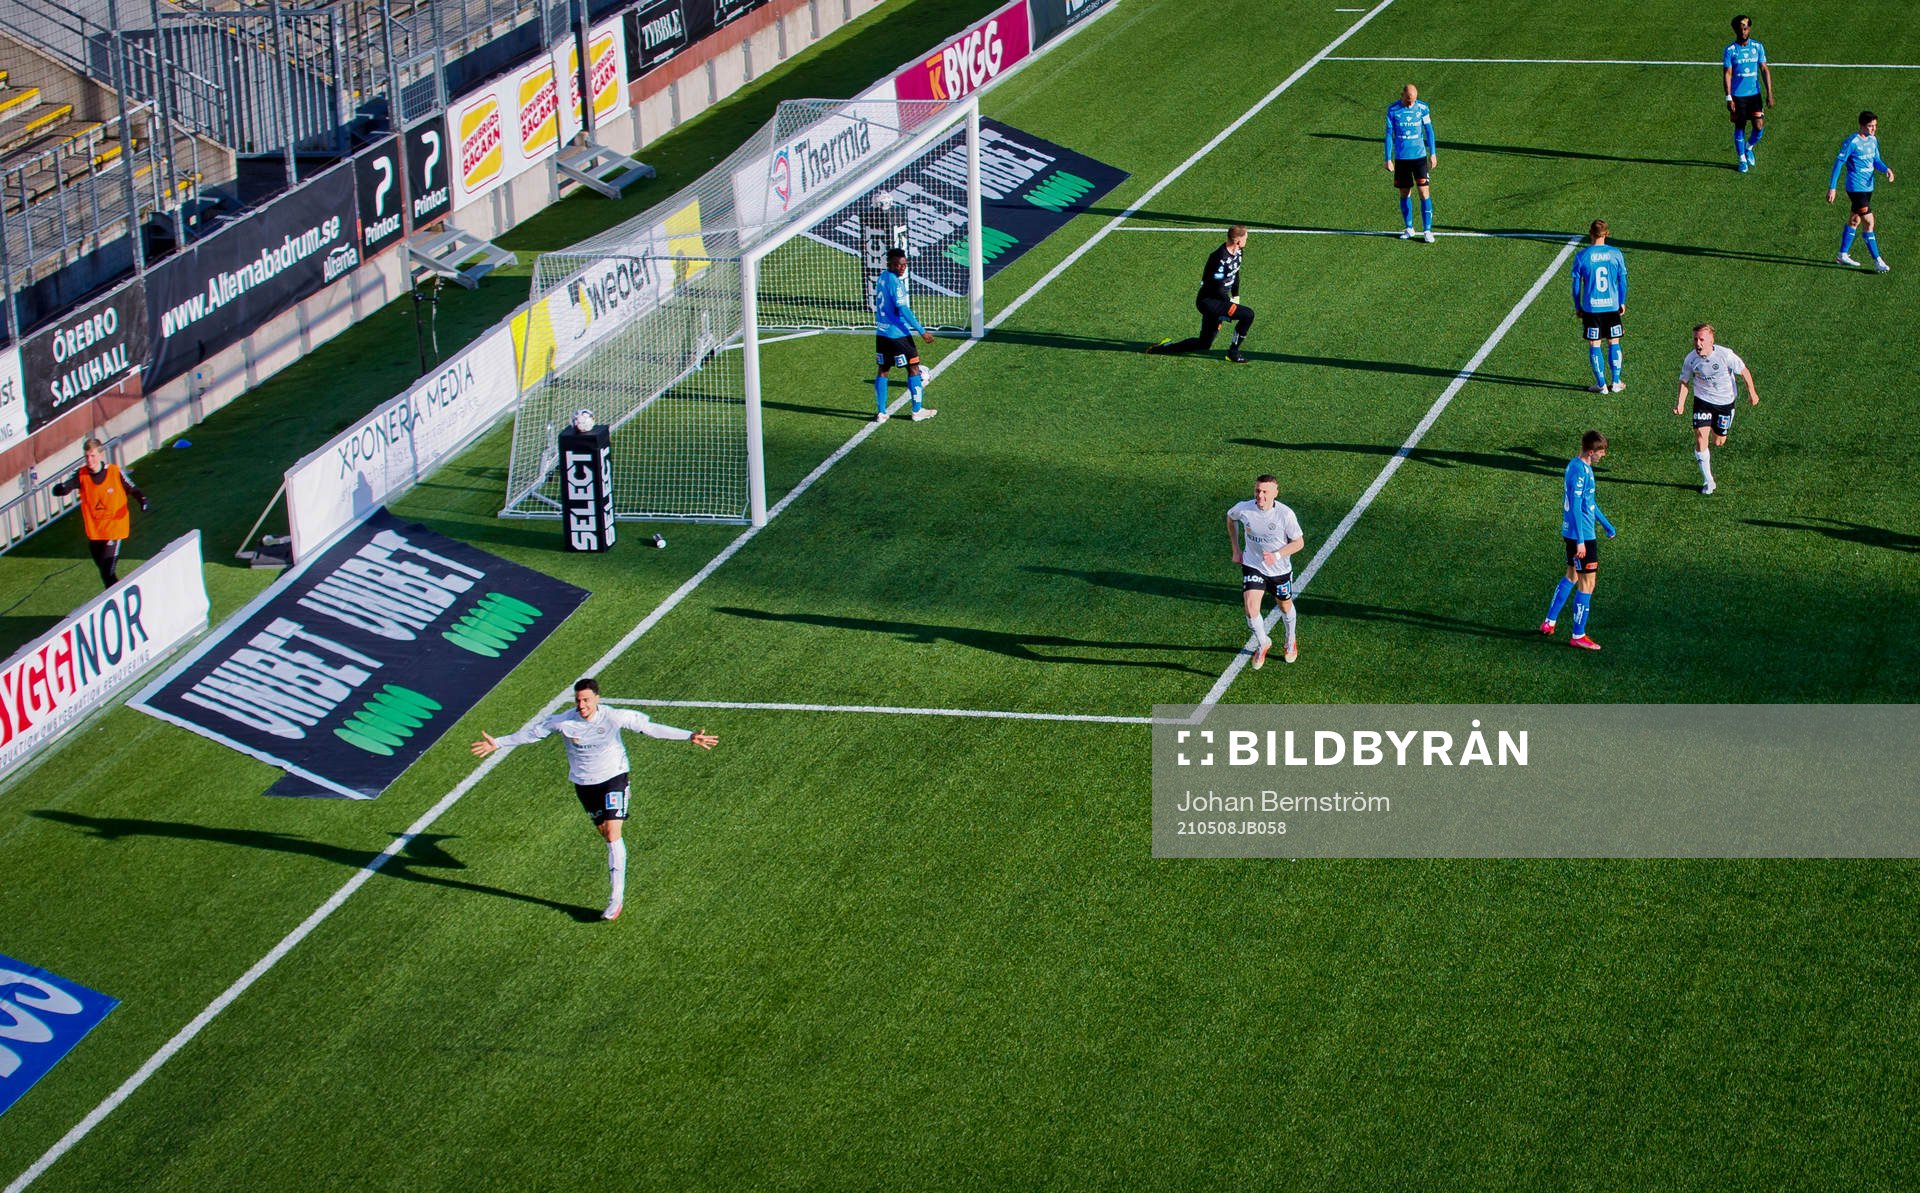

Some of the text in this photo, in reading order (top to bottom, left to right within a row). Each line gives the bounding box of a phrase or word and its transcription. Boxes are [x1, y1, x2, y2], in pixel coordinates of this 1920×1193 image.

[642, 9, 682, 50] TYBBLE
[464, 124, 500, 176] BAGARN
[795, 110, 871, 193] Thermia
[414, 187, 449, 218] Printoz
[365, 214, 401, 246] Printoz
[161, 216, 341, 338] www.Alternabadrum.se
[587, 247, 651, 320] weber
[1595, 266, 1608, 292] 6
[52, 307, 118, 363] ÖREBRO
[0, 376, 15, 407] st
[337, 397, 424, 480] XPONERA
[427, 359, 475, 417] MEDIA
[566, 451, 598, 551] SELECT
